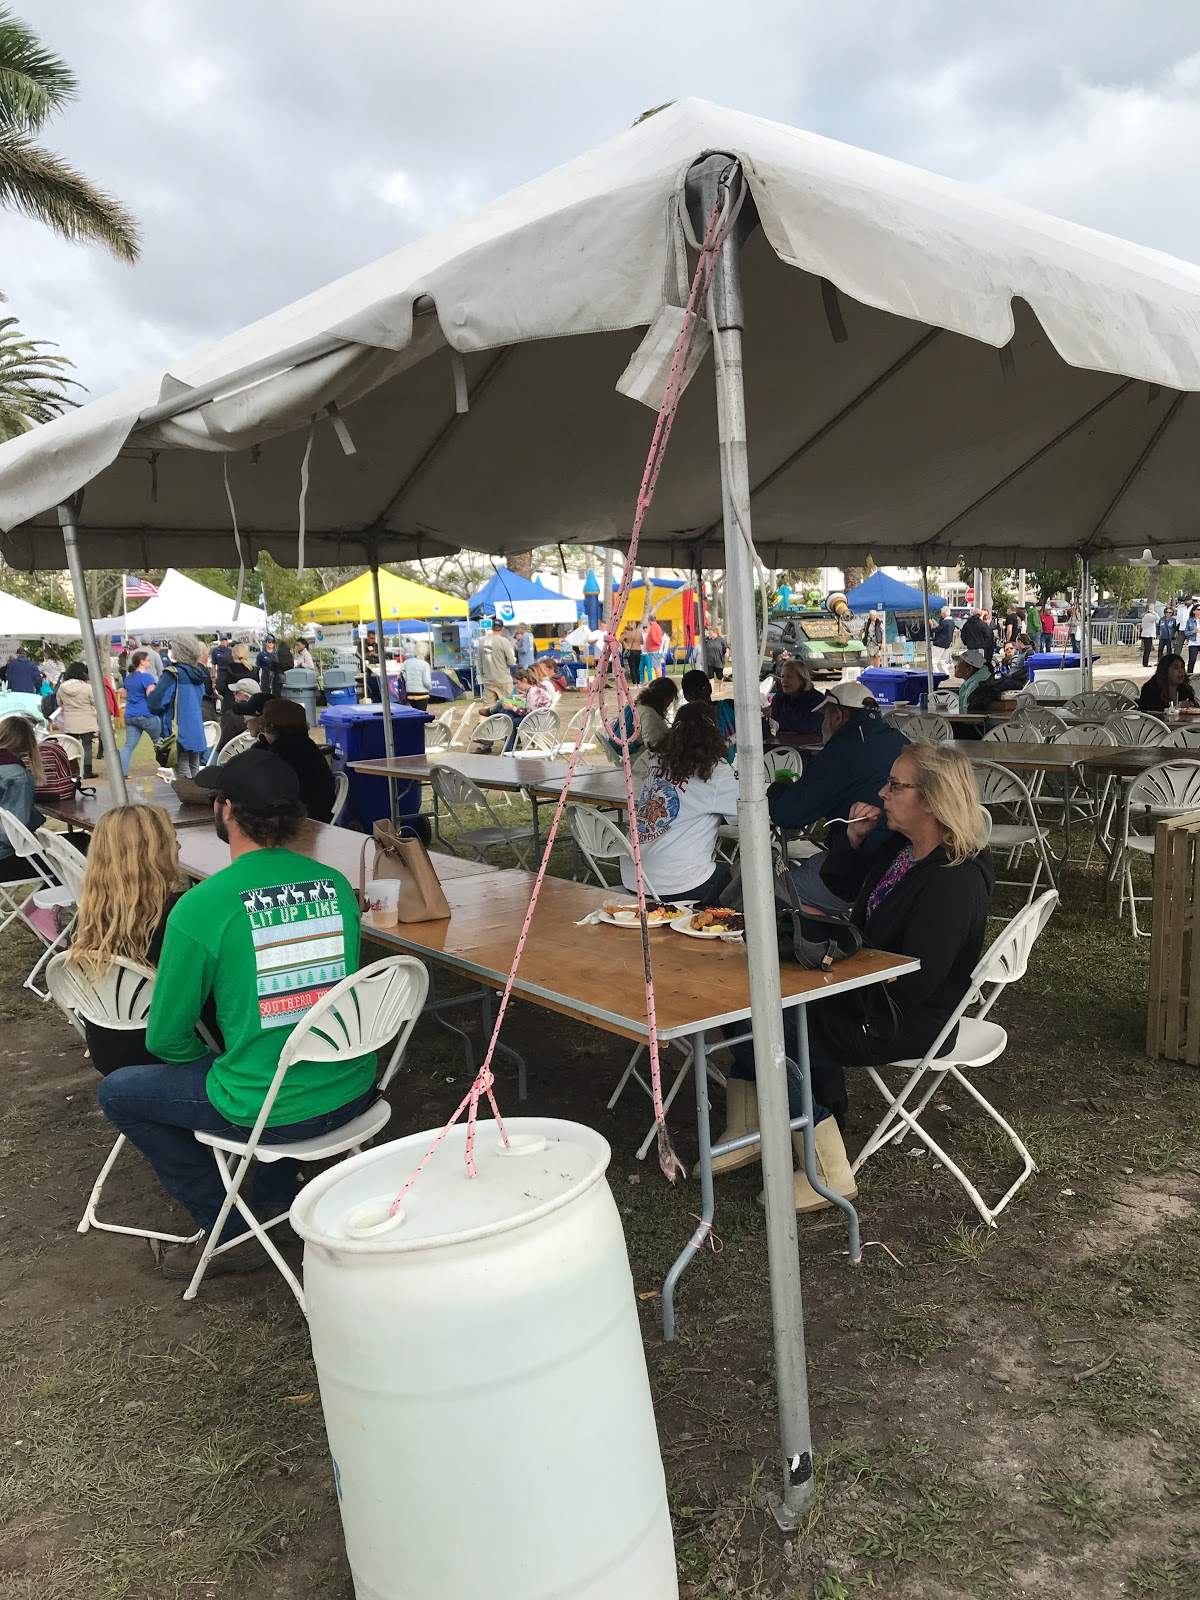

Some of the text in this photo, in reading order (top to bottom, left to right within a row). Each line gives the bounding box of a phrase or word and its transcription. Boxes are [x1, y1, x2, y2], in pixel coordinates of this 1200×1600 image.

[249, 900, 341, 929] LIT UP LIKE
[259, 993, 313, 1015] SOUTHERN
